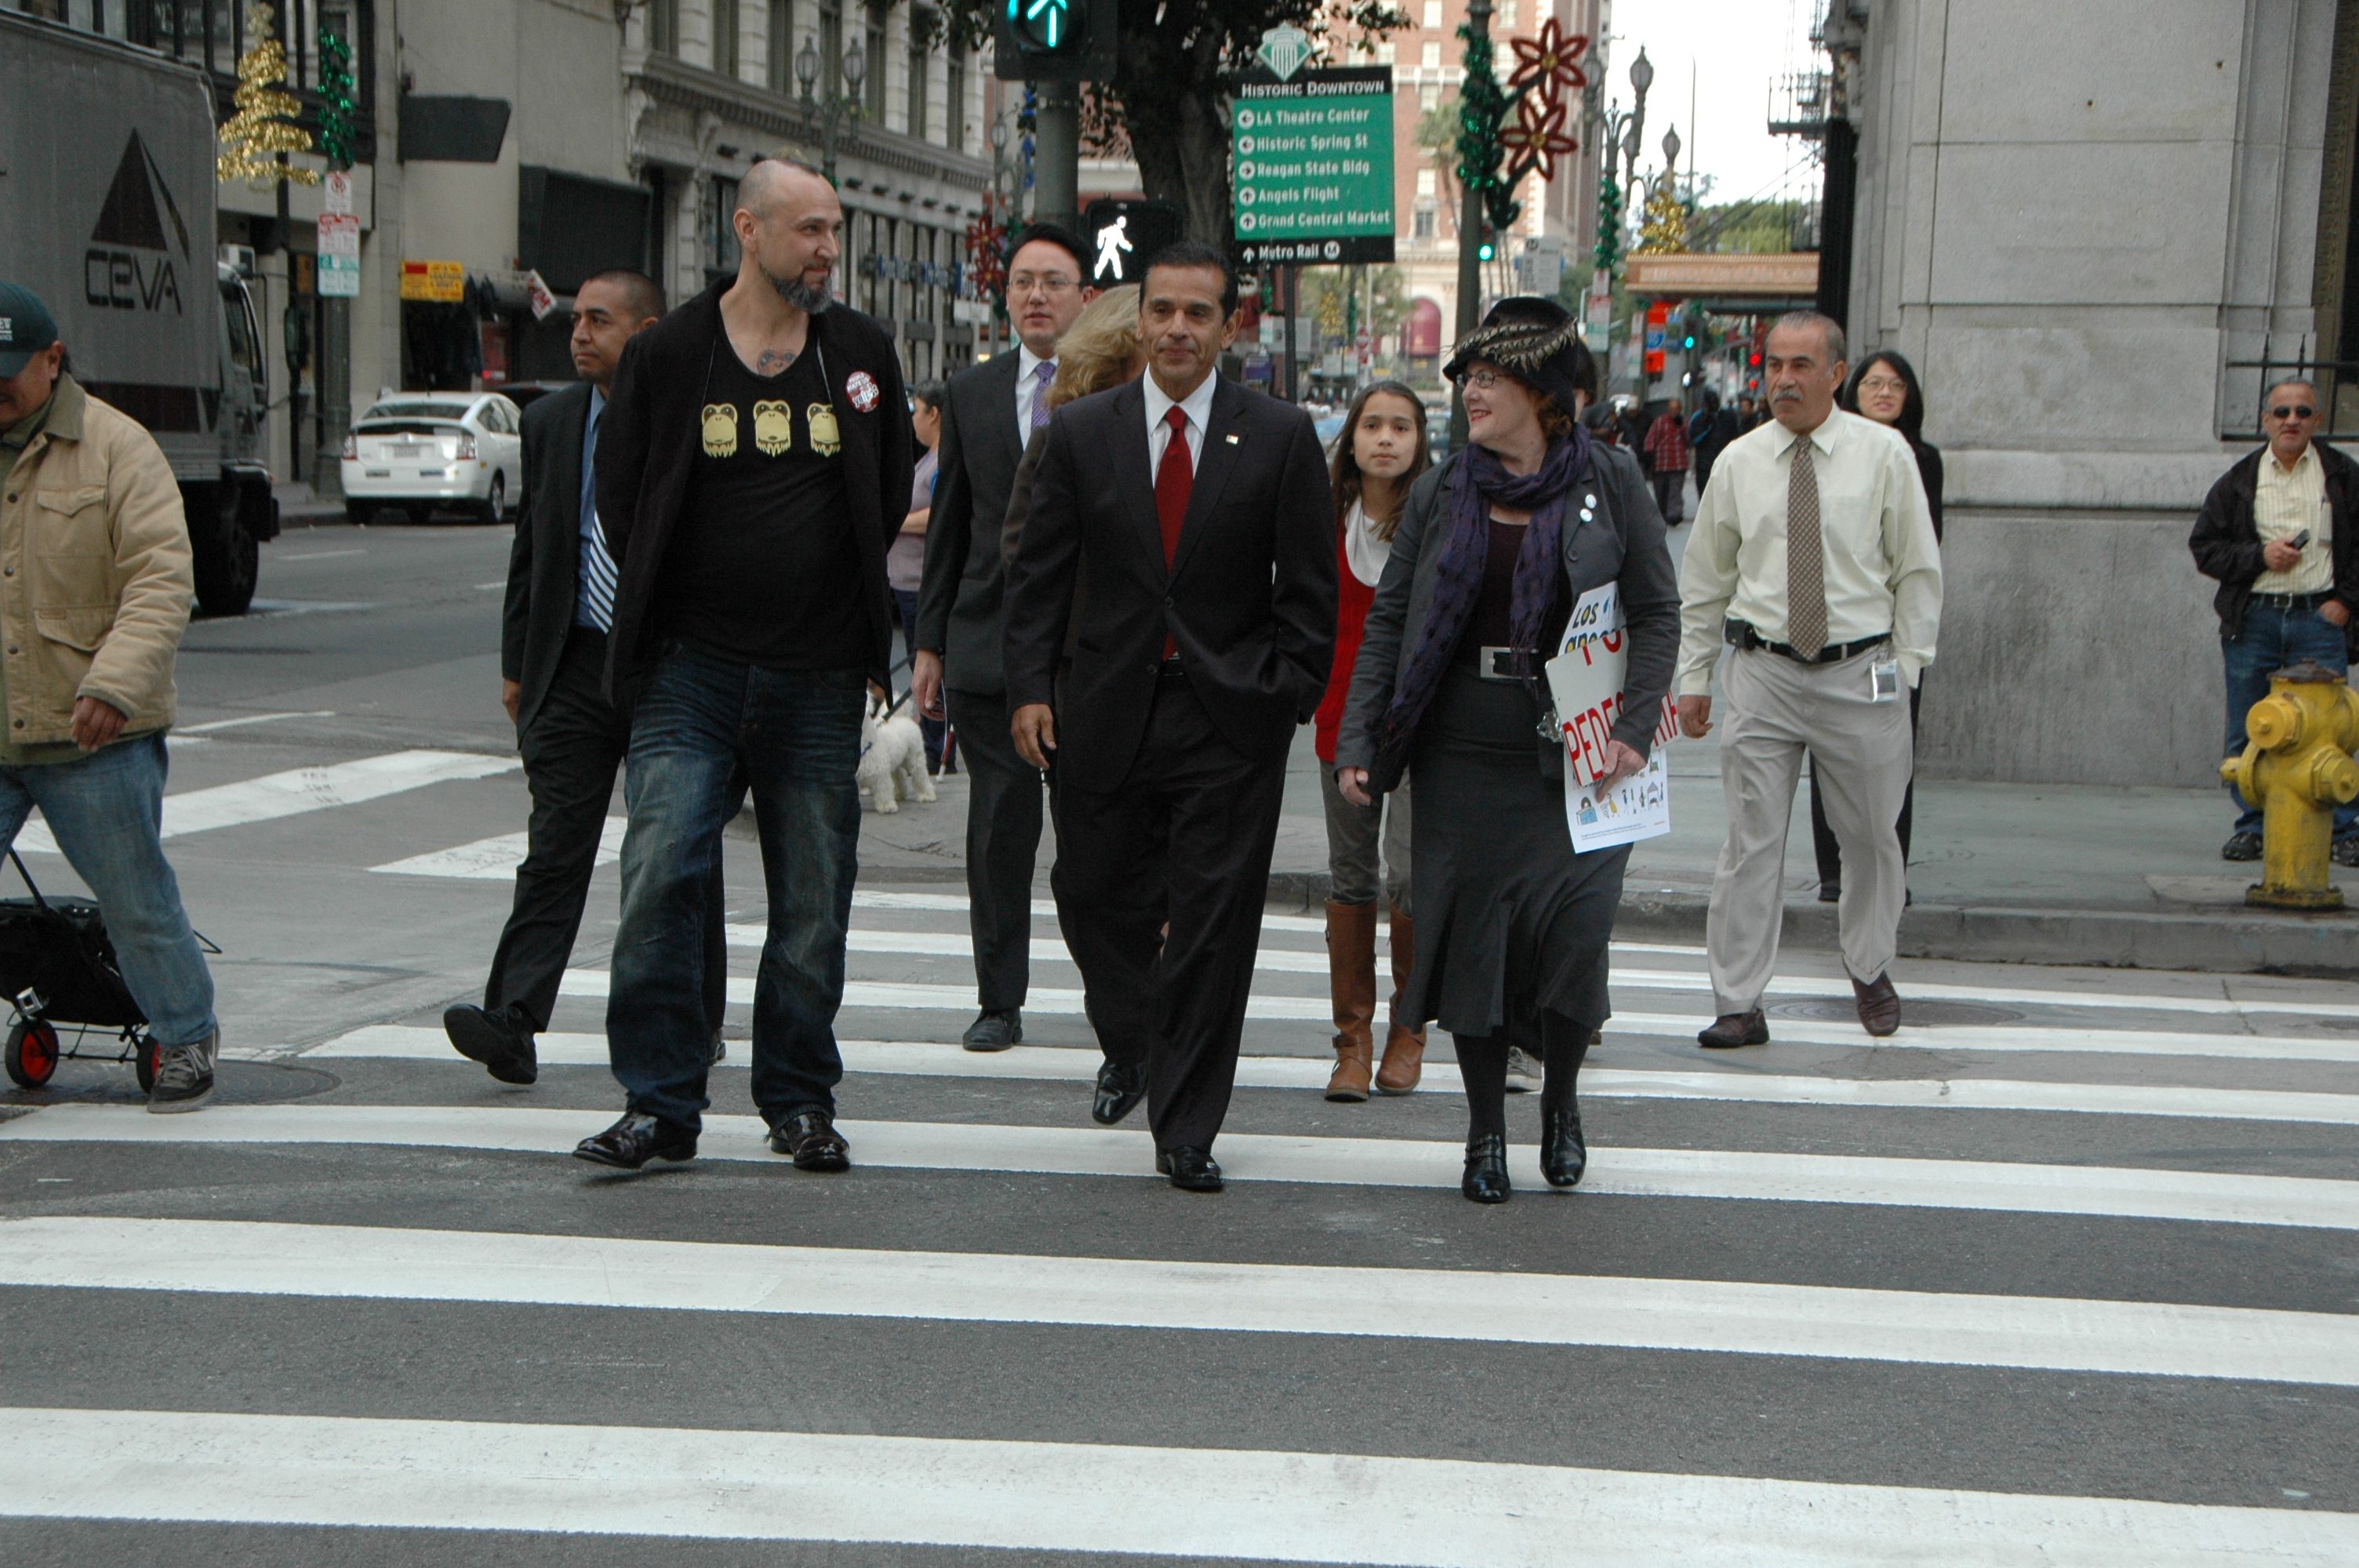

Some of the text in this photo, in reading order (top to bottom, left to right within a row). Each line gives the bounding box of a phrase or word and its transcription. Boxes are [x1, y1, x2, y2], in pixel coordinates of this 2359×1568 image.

[1241, 80, 1385, 98] HISTORIC DOWNTOWN
[1256, 107, 1370, 126] LA Theatre Center
[1257, 133, 1369, 152] Historic Spring St
[1257, 159, 1370, 180] Reagan State Bldg
[1259, 186, 1339, 205] Angels Flight
[1259, 209, 1390, 229] Grand Central Market
[1259, 245, 1294, 260] Metro
[1297, 243, 1319, 259] Rail
[85, 249, 183, 315] CEVA
[1572, 602, 1599, 629] LOS
